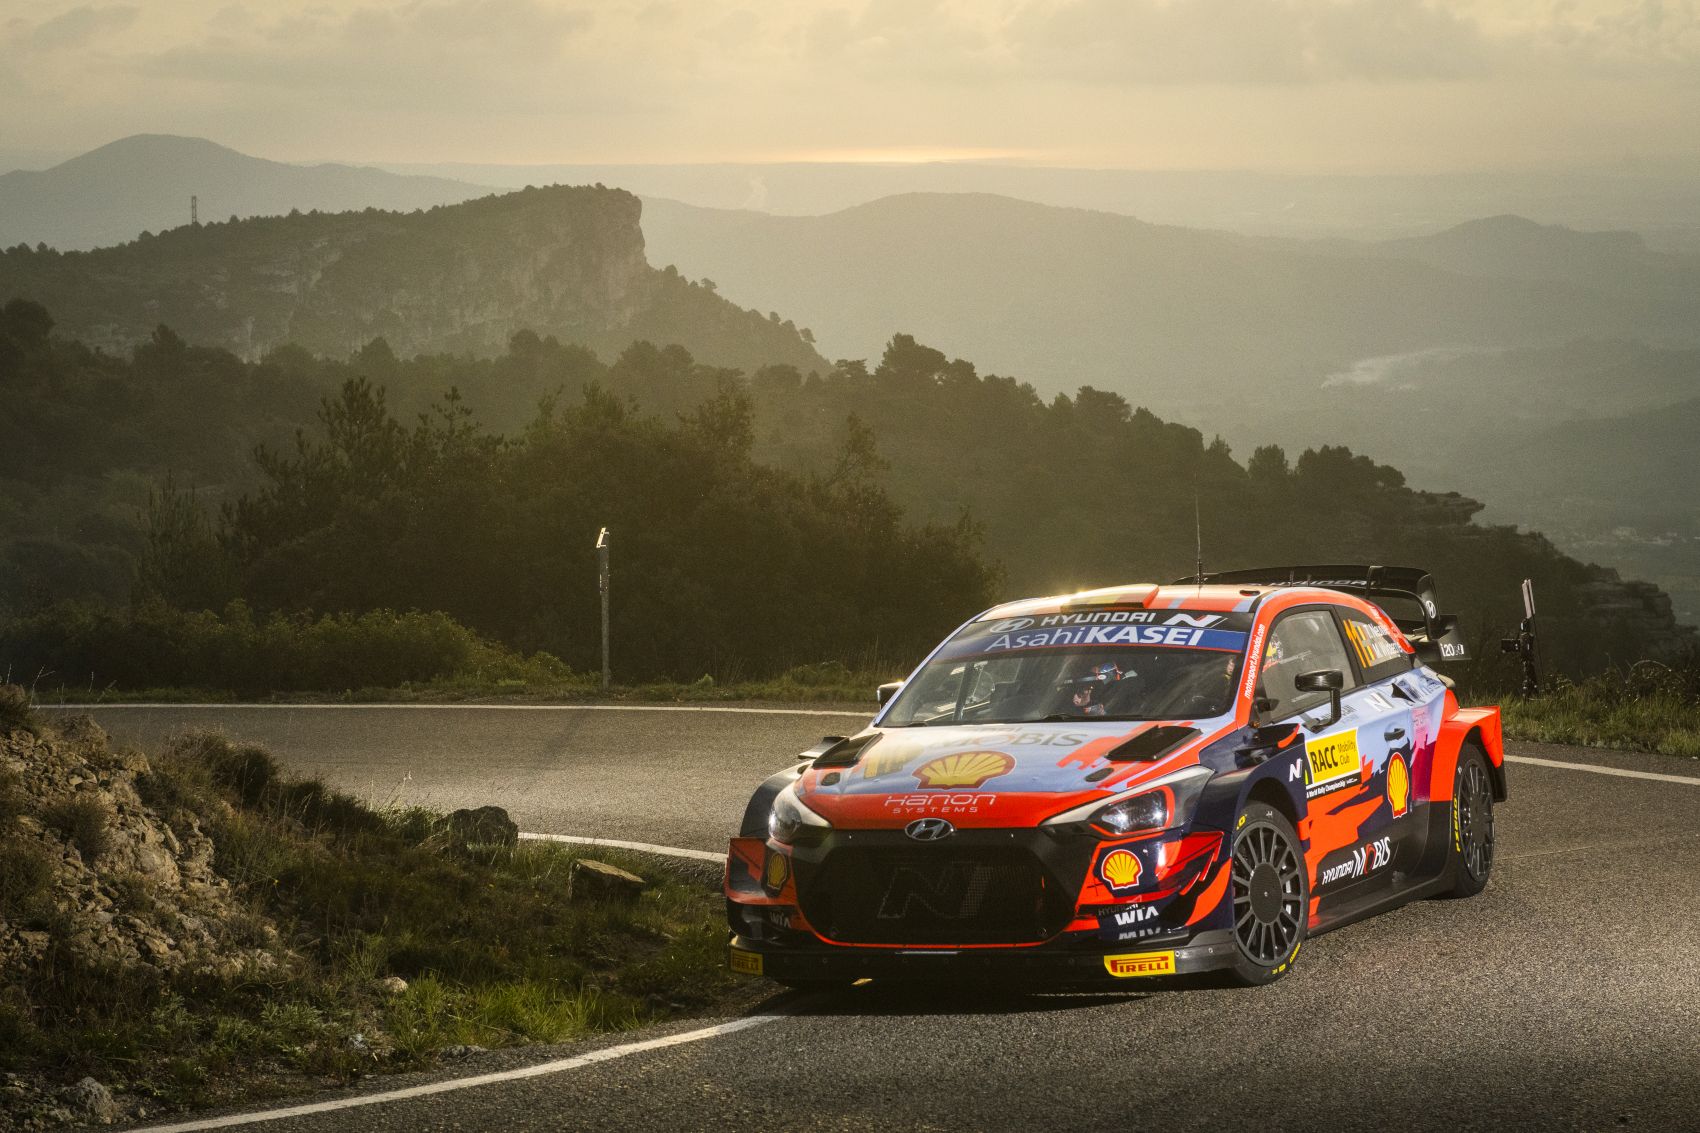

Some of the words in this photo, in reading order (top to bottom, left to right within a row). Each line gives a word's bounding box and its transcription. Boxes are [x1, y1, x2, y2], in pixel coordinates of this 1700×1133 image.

[1040, 612, 1156, 627] HYUNDAI
[984, 626, 1204, 651] AsahiKASEI
[1245, 623, 1265, 699] motorsport.hyundai.com
[1337, 740, 1356, 753] Mobility
[1309, 745, 1339, 773] RACC
[1340, 753, 1350, 766] Club
[892, 806, 979, 814] SYSTEMS
[1322, 860, 1354, 885] HYUNDAI
[1351, 836, 1391, 879] MOBIS
[1115, 906, 1159, 926] WIA
[1110, 956, 1169, 973] PIRELLI
